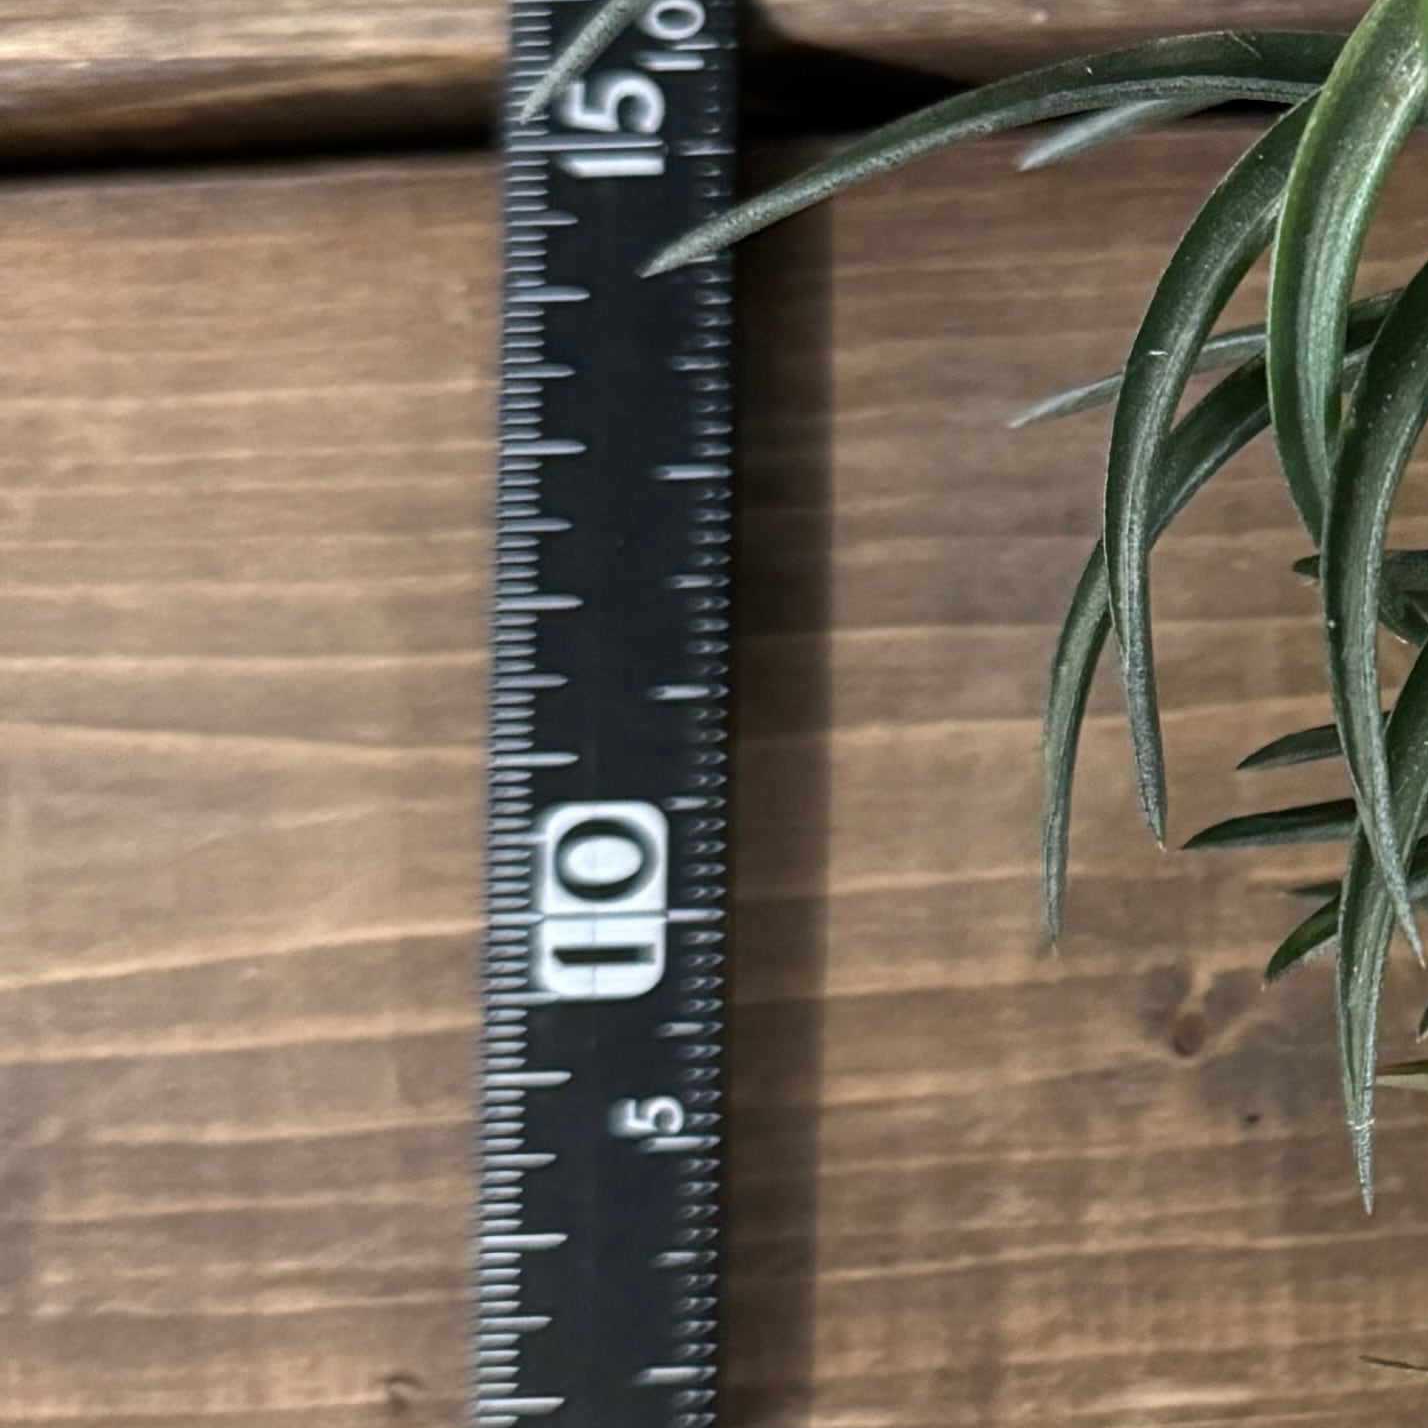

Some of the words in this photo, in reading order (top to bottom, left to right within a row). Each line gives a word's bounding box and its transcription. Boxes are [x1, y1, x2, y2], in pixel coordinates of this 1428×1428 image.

[560, 73, 666, 178] 15
[551, 817, 660, 966] 10
[613, 1095, 686, 1137] 5
